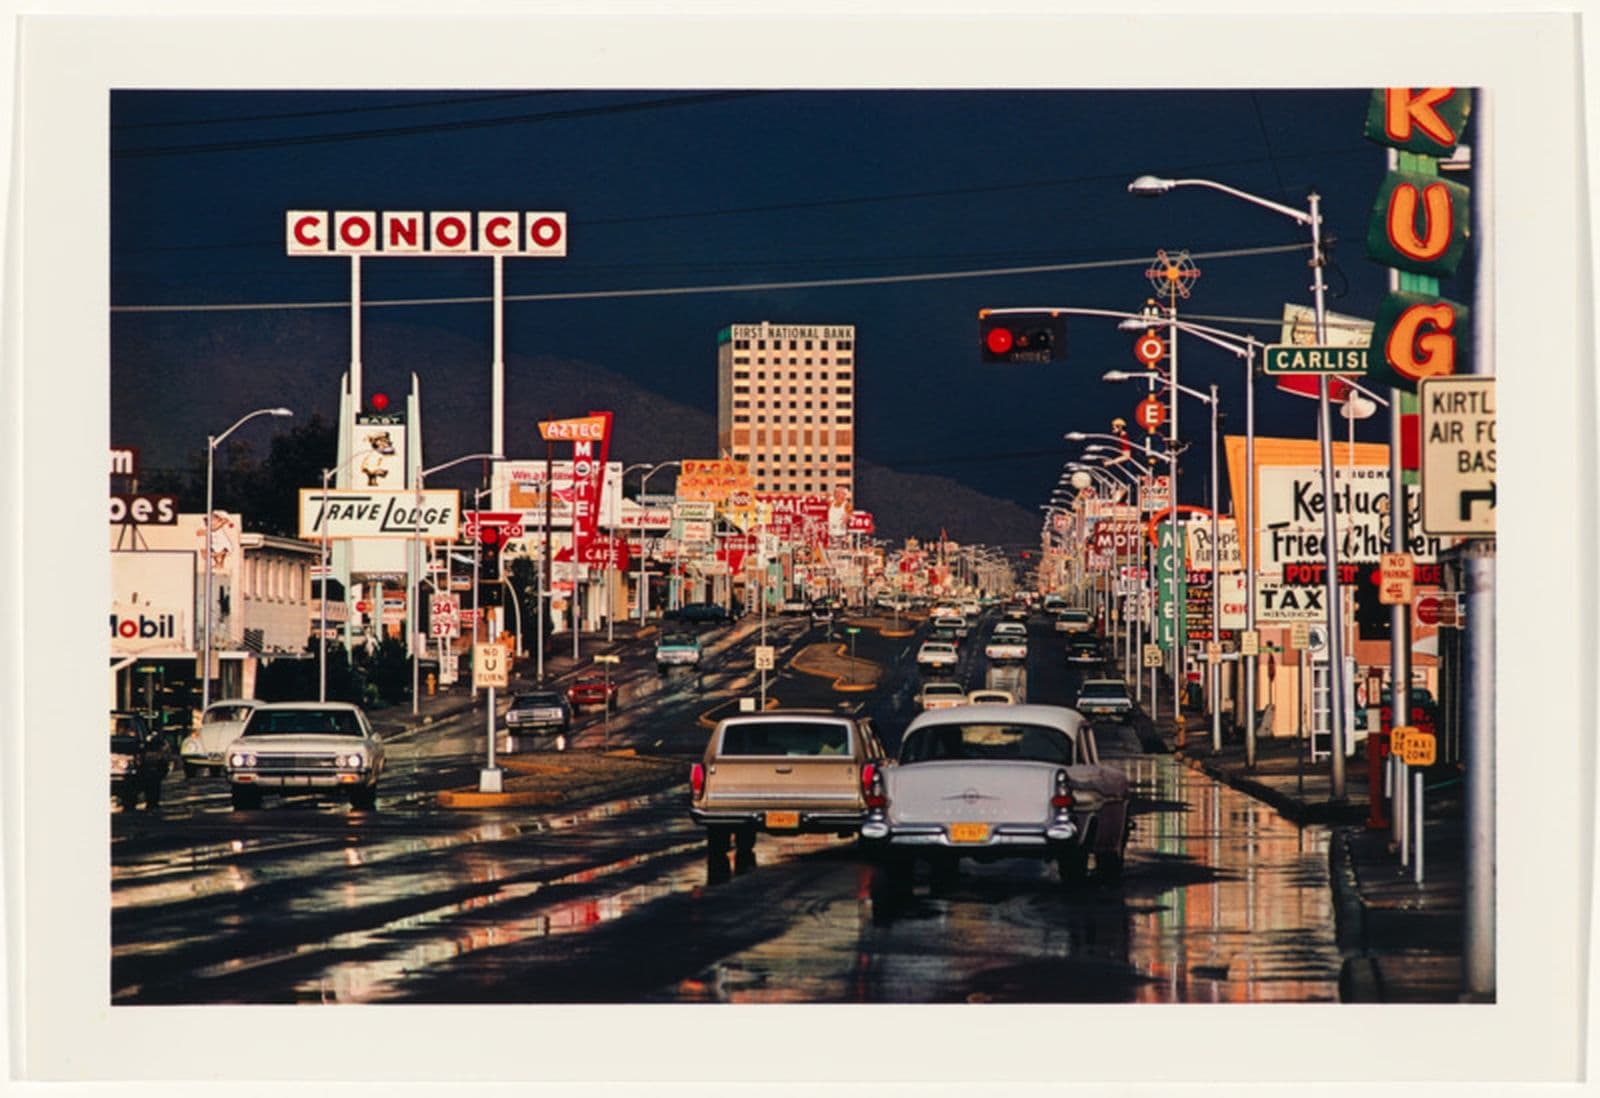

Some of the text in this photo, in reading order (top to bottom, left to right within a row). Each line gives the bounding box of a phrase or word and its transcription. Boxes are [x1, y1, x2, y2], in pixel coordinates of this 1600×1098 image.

[293, 216, 562, 248] CONOCO
[734, 327, 853, 339] FIRST NATIONAL BANK
[547, 422, 601, 437] AZTEC
[1429, 421, 1464, 443] AIR
[575, 441, 591, 537] MOTEL
[585, 548, 620, 561] CAFE
[1389, 558, 1405, 567] NO
[1162, 531, 1181, 646] MOTEL
[1259, 590, 1323, 610] TAX
[483, 648, 499, 657] NO
[484, 659, 497, 671] U
[478, 673, 505, 681] TURN
[1406, 739, 1432, 748] TAXI
[1406, 750, 1432, 760] ZONE
